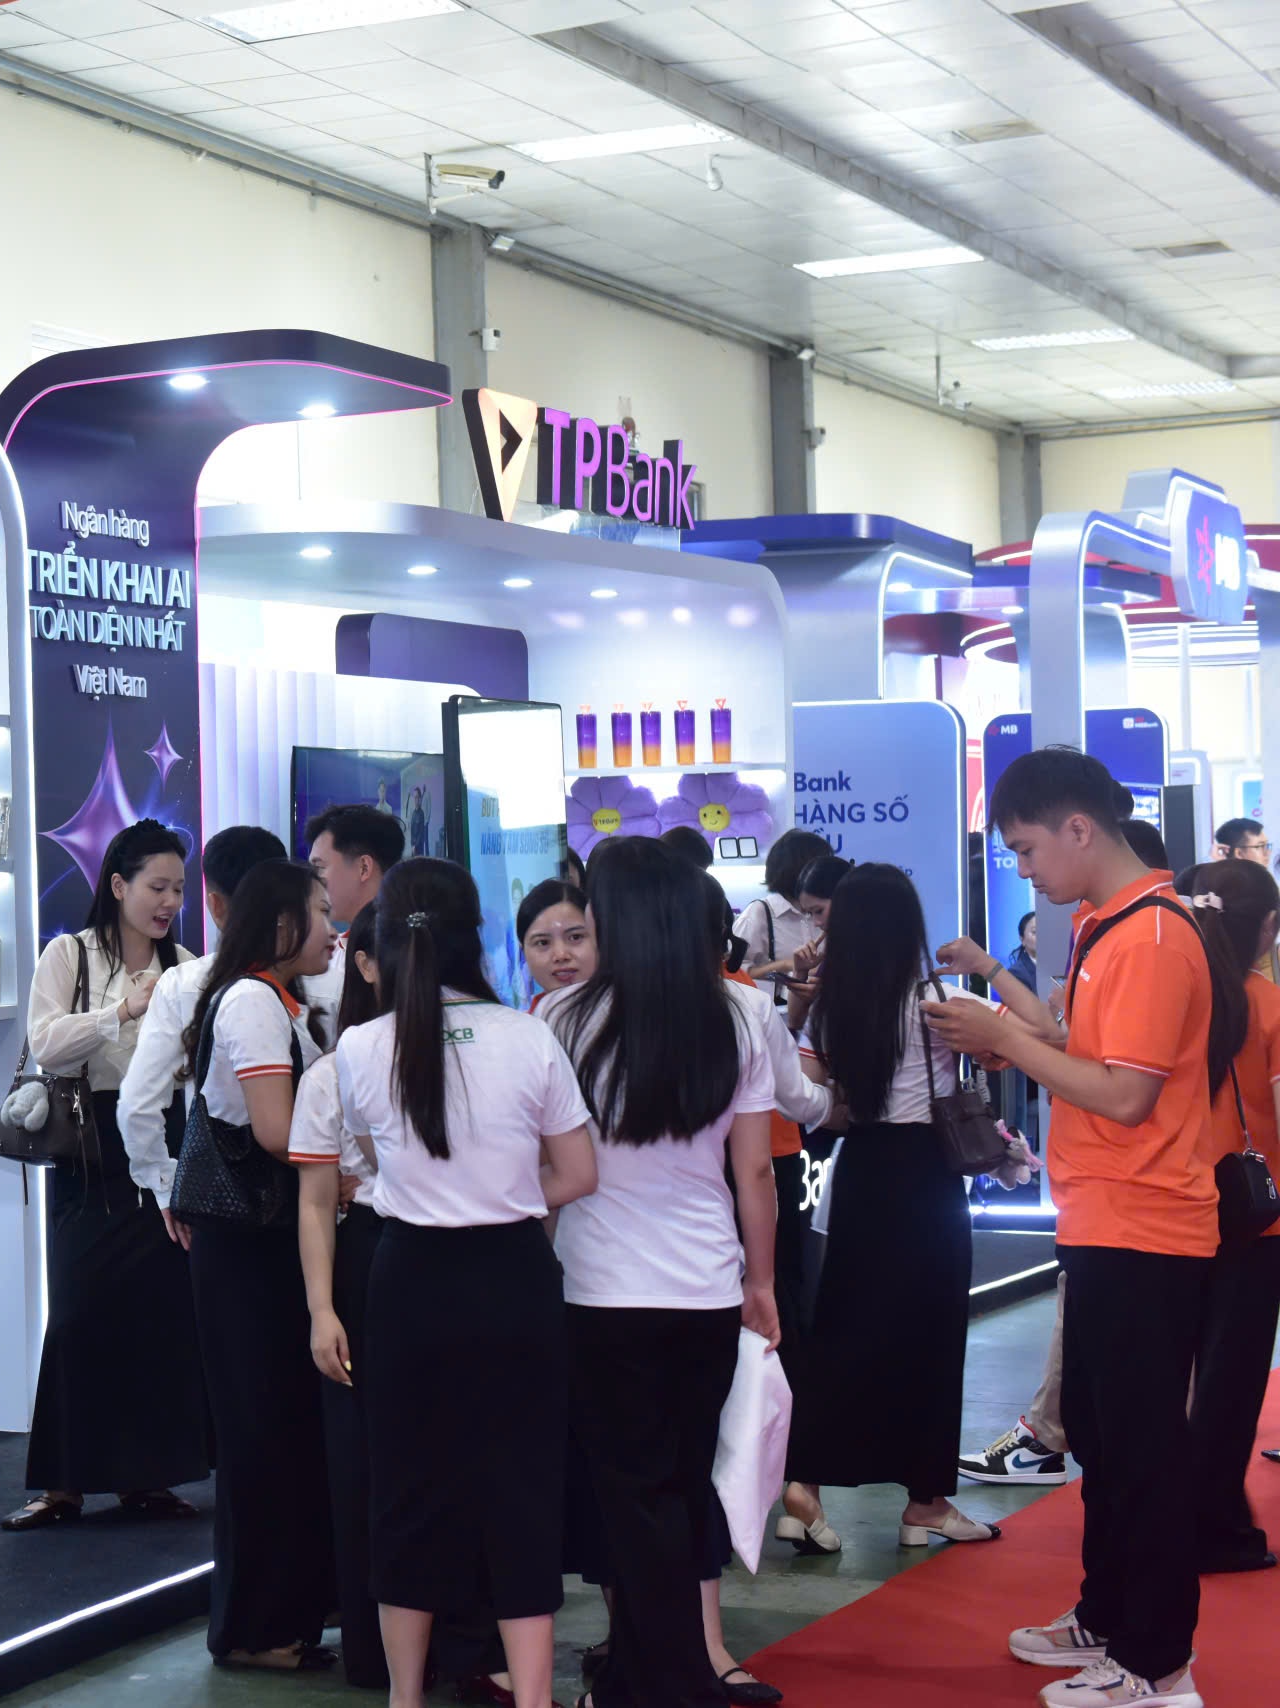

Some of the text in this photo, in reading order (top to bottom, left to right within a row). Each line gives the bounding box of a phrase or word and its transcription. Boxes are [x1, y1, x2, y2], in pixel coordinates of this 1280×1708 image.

[541, 407, 697, 530] TPBank
[61, 500, 150, 547] Ngân hàng
[27, 540, 191, 609] TRIỂN KHAI AI
[30, 600, 187, 653] TOÀN DIỆN NHẤT
[73, 663, 147, 701] Việt Nam
[1000, 724, 1018, 735] MB
[794, 770, 852, 793] Bank
[873, 794, 910, 823] SỐ
